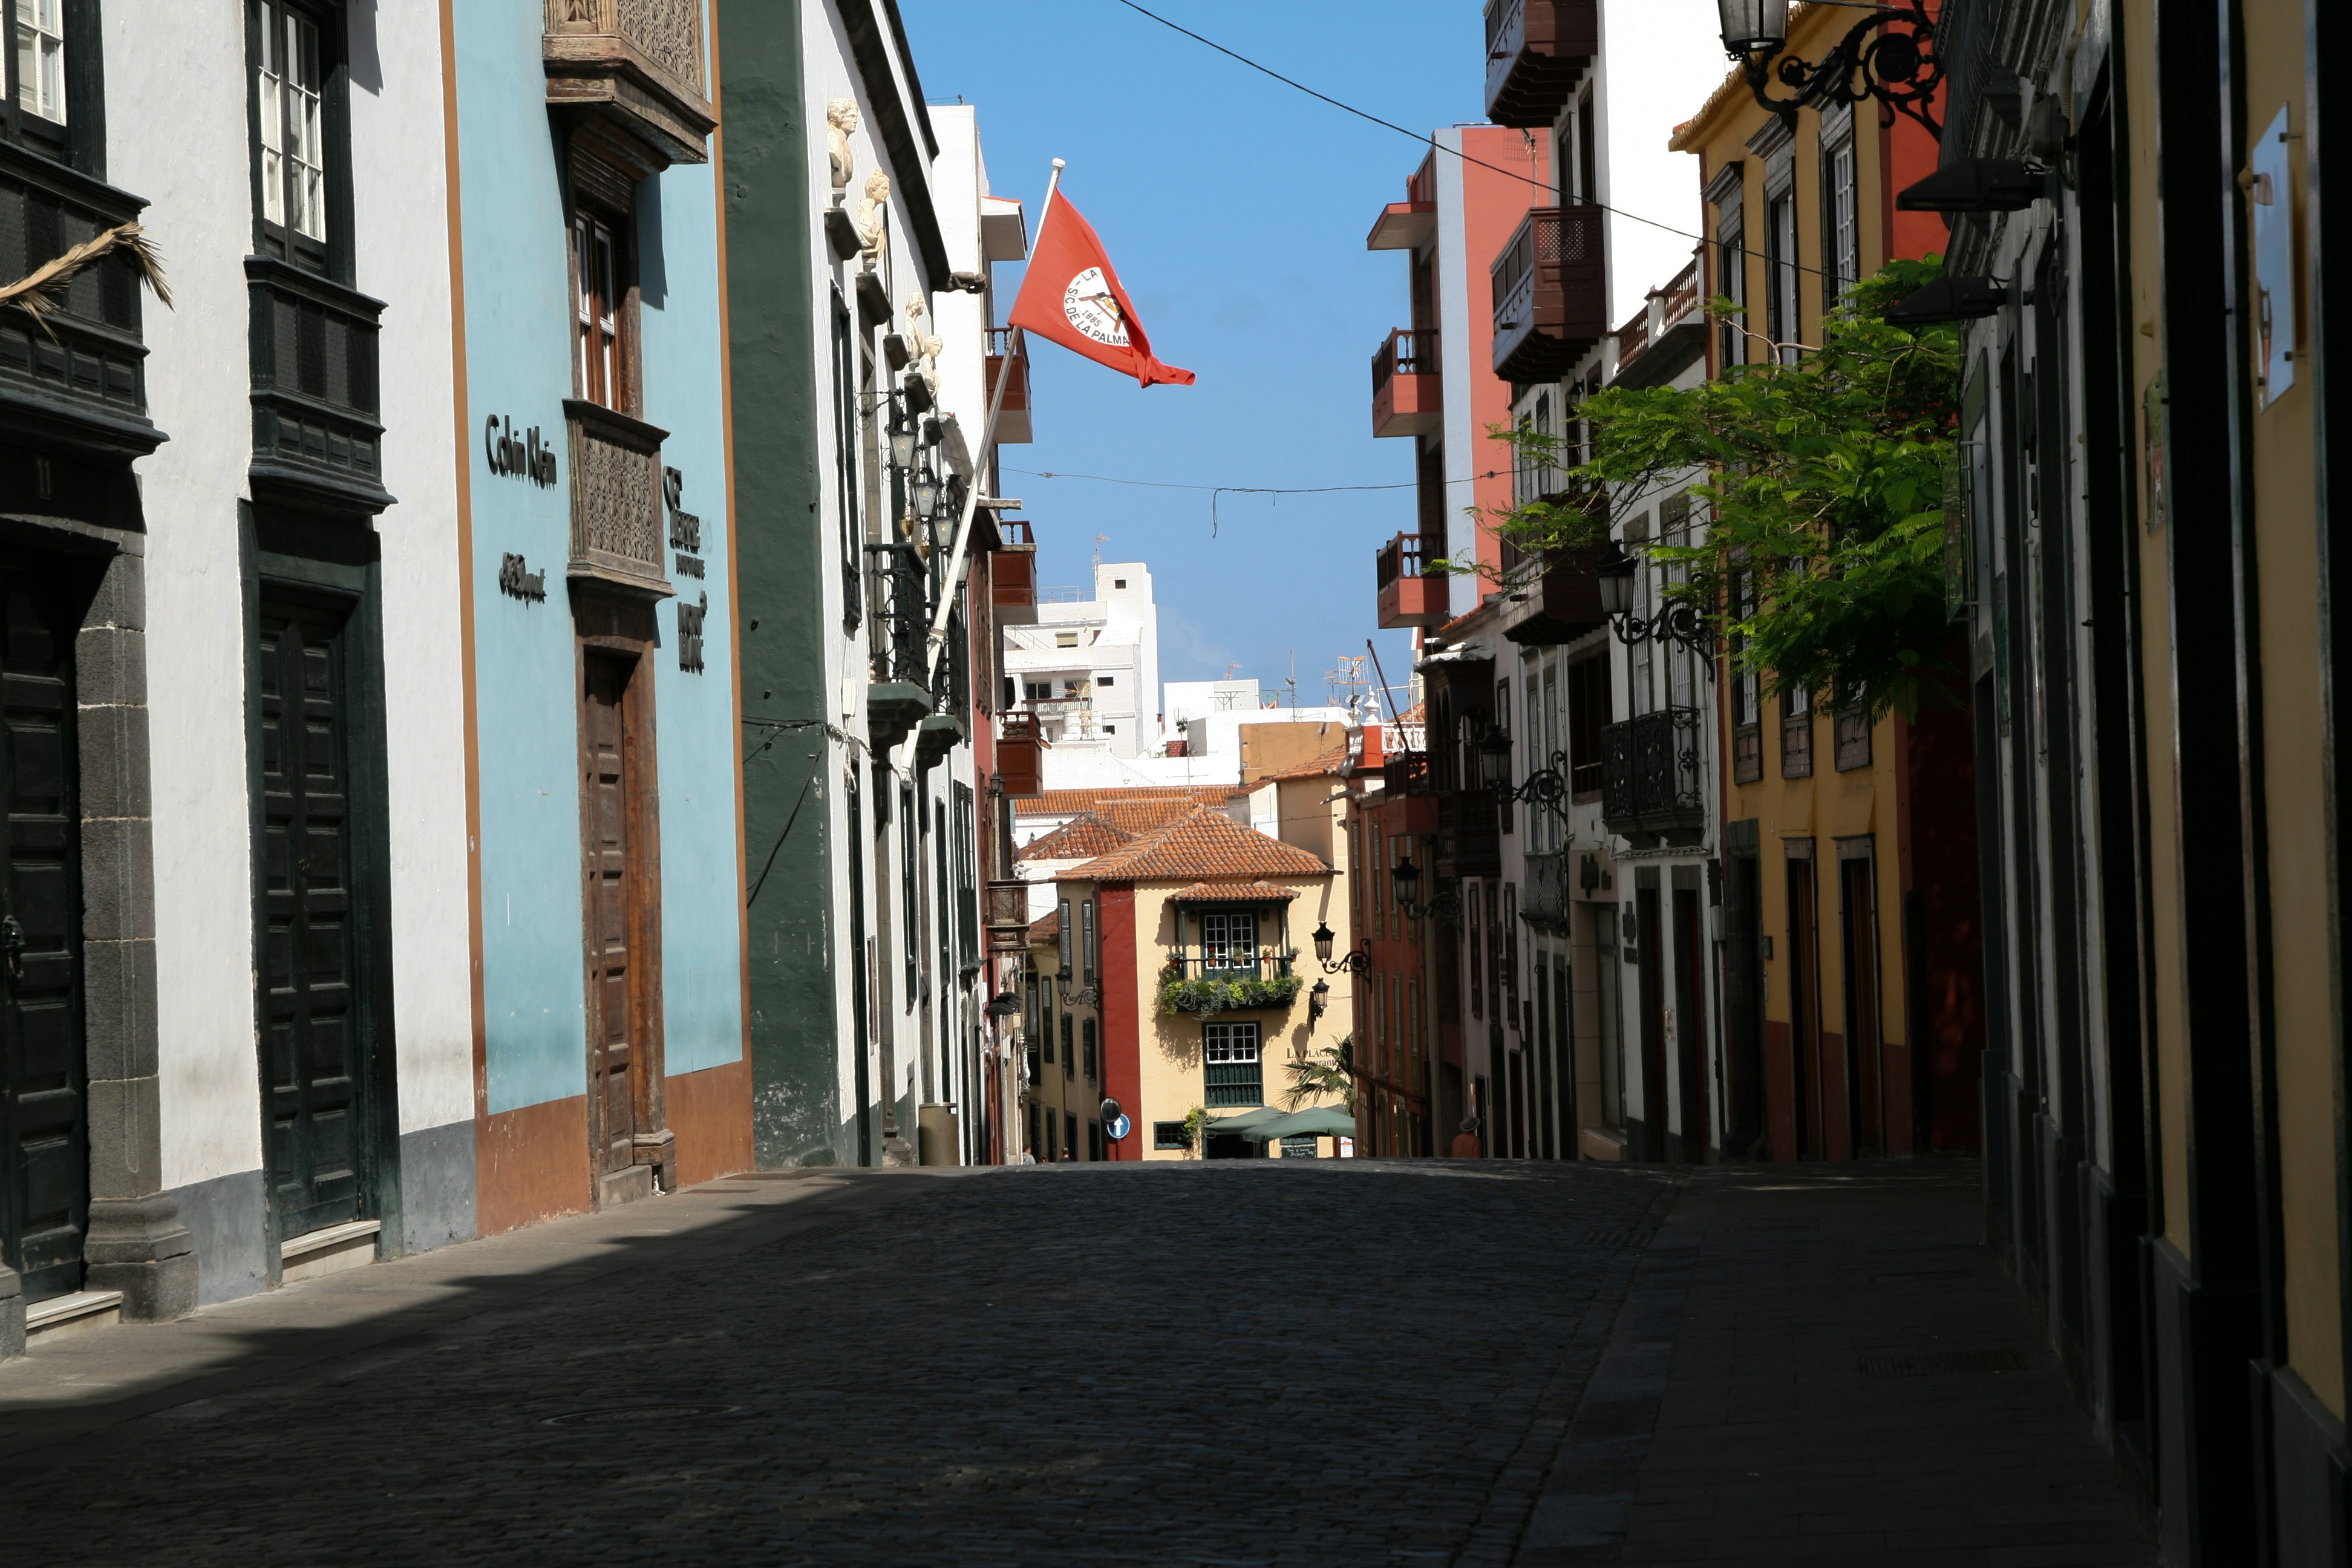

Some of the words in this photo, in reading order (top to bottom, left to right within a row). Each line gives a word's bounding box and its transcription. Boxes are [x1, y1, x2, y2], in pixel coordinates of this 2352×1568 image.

[1081, 269, 1099, 281] LA
[1066, 307, 1080, 321] DE
[1076, 321, 1091, 335] LA
[1091, 330, 1130, 345] PALMA
[1082, 310, 1102, 327] 1885
[485, 414, 526, 478] Calvin
[527, 425, 557, 490] Klein
